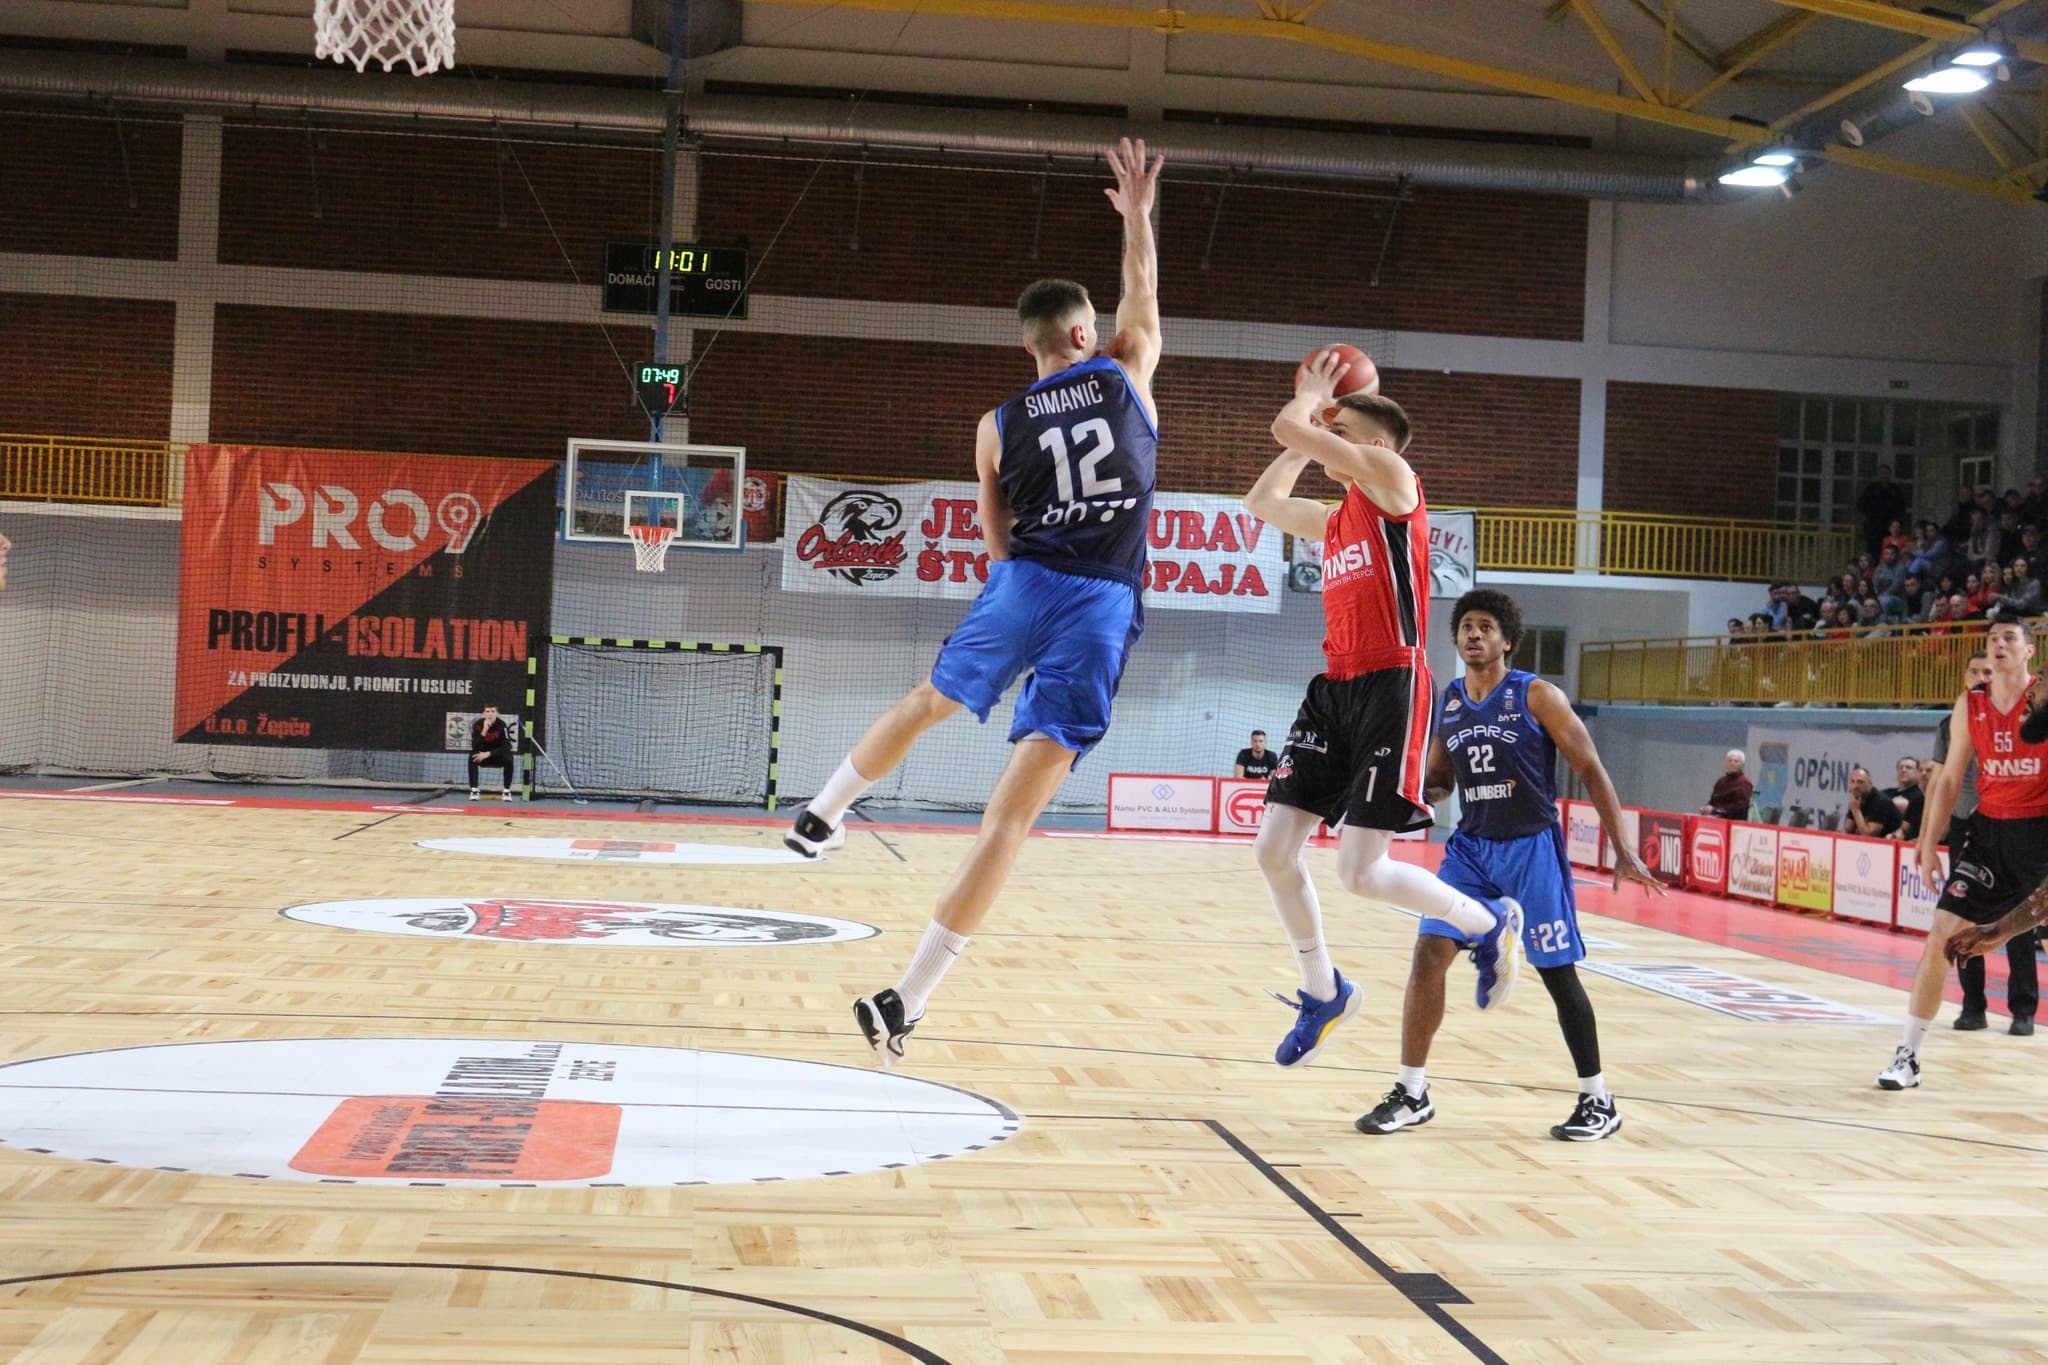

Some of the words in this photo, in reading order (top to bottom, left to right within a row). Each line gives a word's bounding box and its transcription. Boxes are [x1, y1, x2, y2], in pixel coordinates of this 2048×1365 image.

[705, 279, 742, 291] GOSTI
[642, 367, 680, 384] 07:49
[663, 383, 676, 404] 7
[1025, 374, 1104, 418] SIMANIĆ
[1038, 417, 1123, 503] 12
[921, 498, 985, 540] JE
[796, 523, 909, 565] Orlovik
[258, 556, 464, 579] SYSTEMS
[228, 671, 248, 686] ZA
[353, 676, 411, 693] PROMET
[413, 678, 419, 693] I
[421, 679, 473, 695] USLUGE
[205, 716, 252, 735] d.o.o.
[256, 713, 312, 738] Žepče
[1446, 724, 1519, 752] SPARS
[1994, 731, 2013, 753] 55
[1467, 744, 1496, 774] 22
[1795, 752, 1860, 793] OPĆIN
[1365, 766, 1378, 802] 1
[1137, 805, 1153, 813] PVC
[1179, 806, 1211, 816] Systems
[1538, 919, 1570, 953] 22
